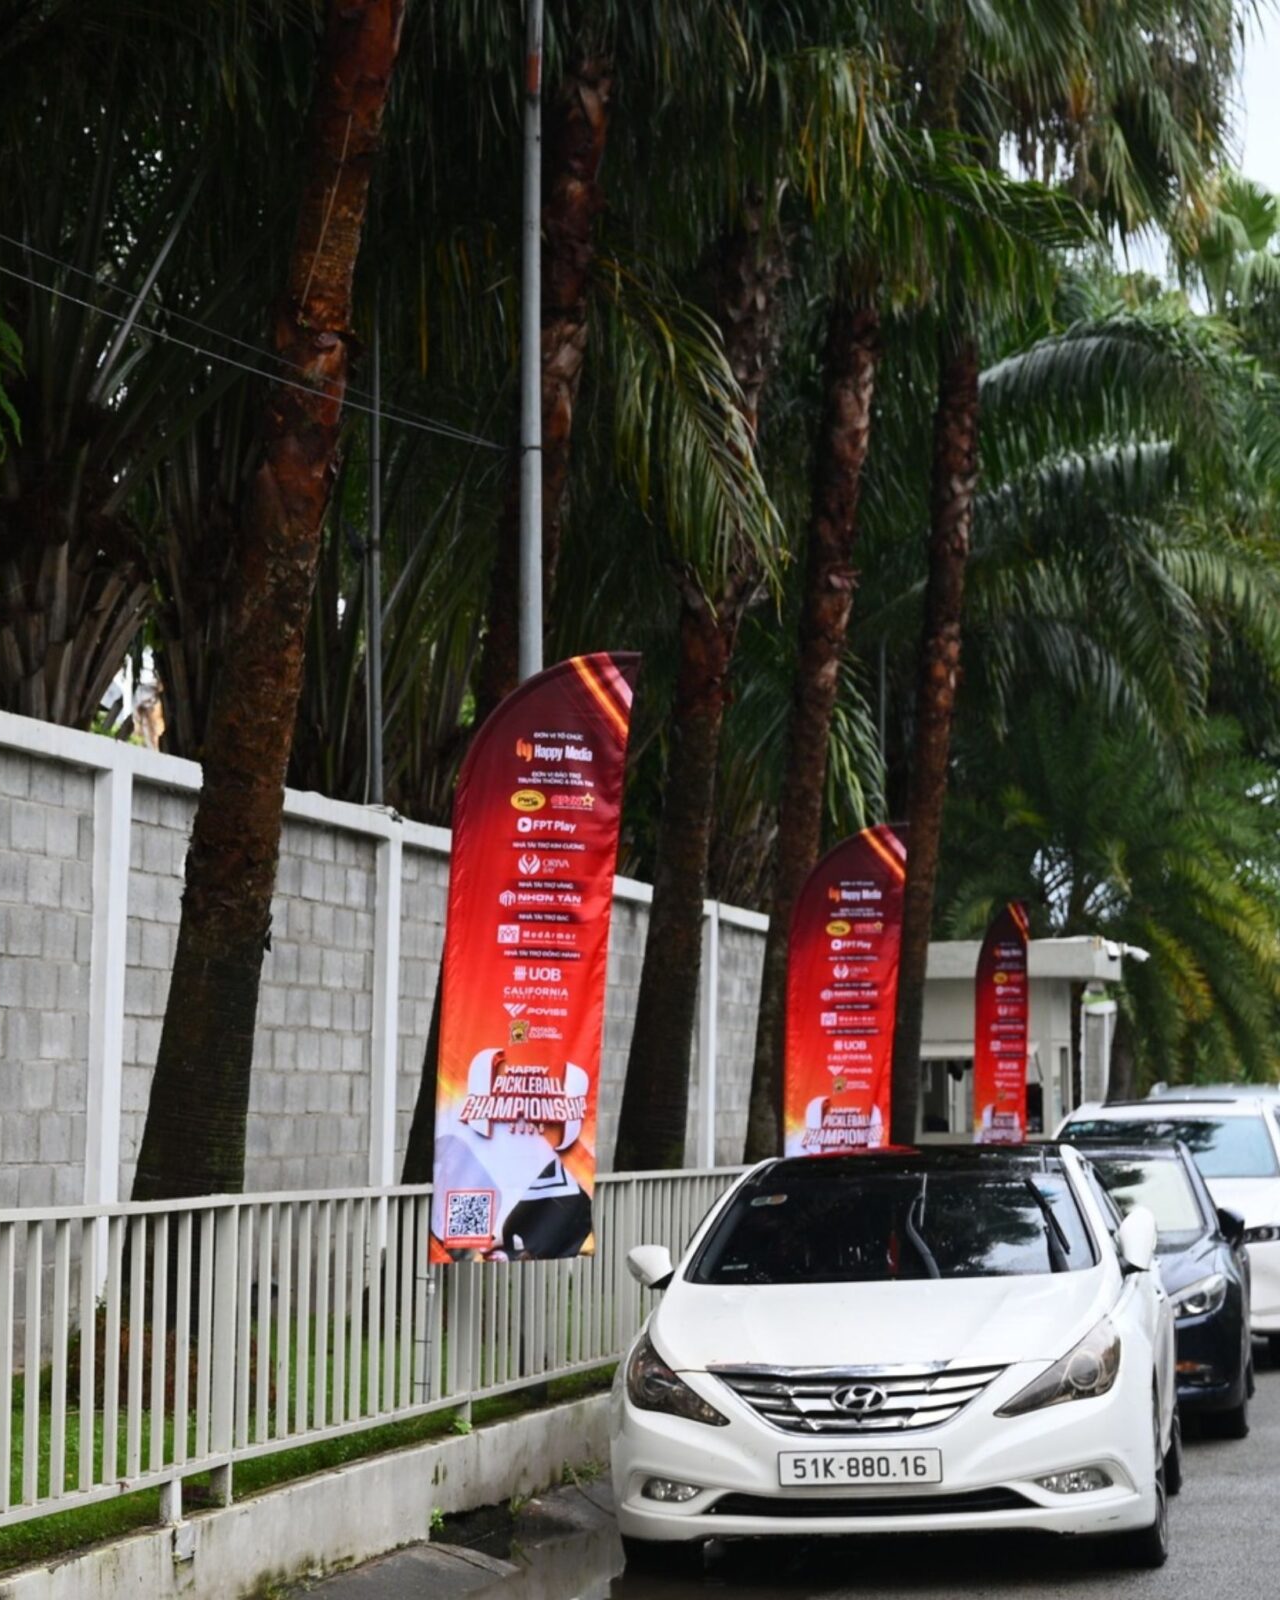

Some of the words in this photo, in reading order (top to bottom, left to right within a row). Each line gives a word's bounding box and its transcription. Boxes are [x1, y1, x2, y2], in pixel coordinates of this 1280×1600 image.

[534, 744, 564, 762] Happy
[564, 745, 593, 762] Media
[532, 820, 552, 830] FPT
[554, 820, 577, 834] Play
[529, 967, 562, 981] UOB
[503, 986, 569, 997] CALIFORNIA
[526, 1007, 568, 1016] POVISS
[504, 1065, 549, 1074] HAPPY
[492, 1076, 566, 1095] PICKLEBALL
[793, 1455, 927, 1479] 51K-880.16
